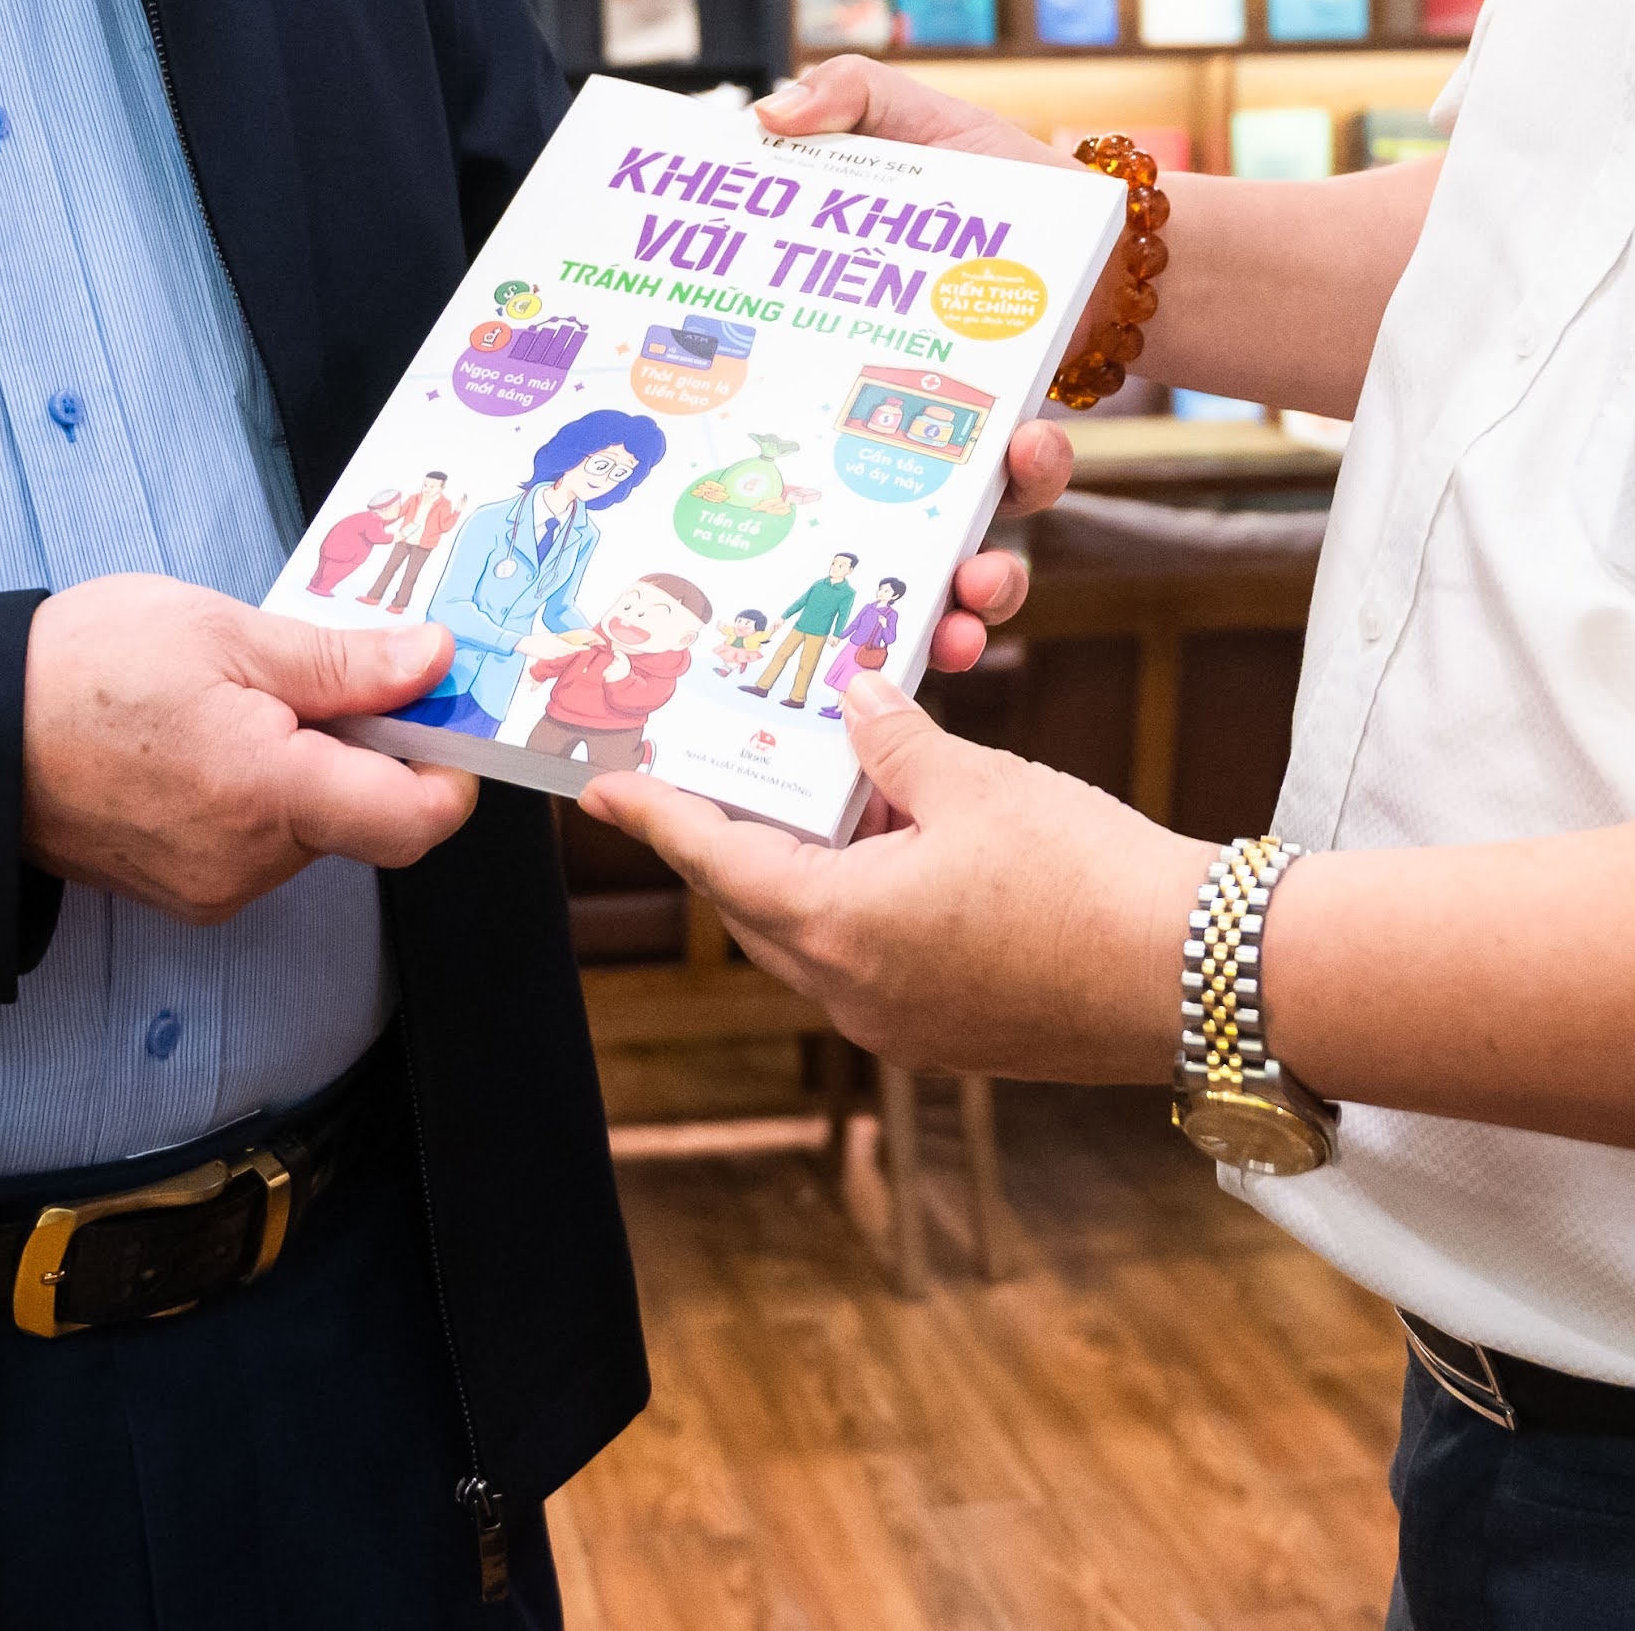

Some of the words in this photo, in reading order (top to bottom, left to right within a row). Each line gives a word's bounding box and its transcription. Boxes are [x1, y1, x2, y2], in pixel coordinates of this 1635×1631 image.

[885, 161, 923, 175] SEN
[608, 146, 801, 218] KHÉO
[810, 188, 1012, 258] KHÔN
[633, 214, 747, 277] VỚI
[768, 239, 927, 315] TIỀN
[939, 280, 984, 297] KIẾN
[988, 286, 1040, 302] THỨC
[559, 260, 663, 298] TRÁNH
[667, 281, 785, 322] NHỮNG
[847, 320, 954, 363] PHIỀN
[940, 295, 969, 311] TÀI
[973, 299, 1035, 317] CHÍNH
[504, 372, 524, 385] có
[675, 375, 711, 390] gian
[465, 380, 495, 395] mới
[497, 388, 534, 407] sáng
[693, 528, 713, 541] ra
